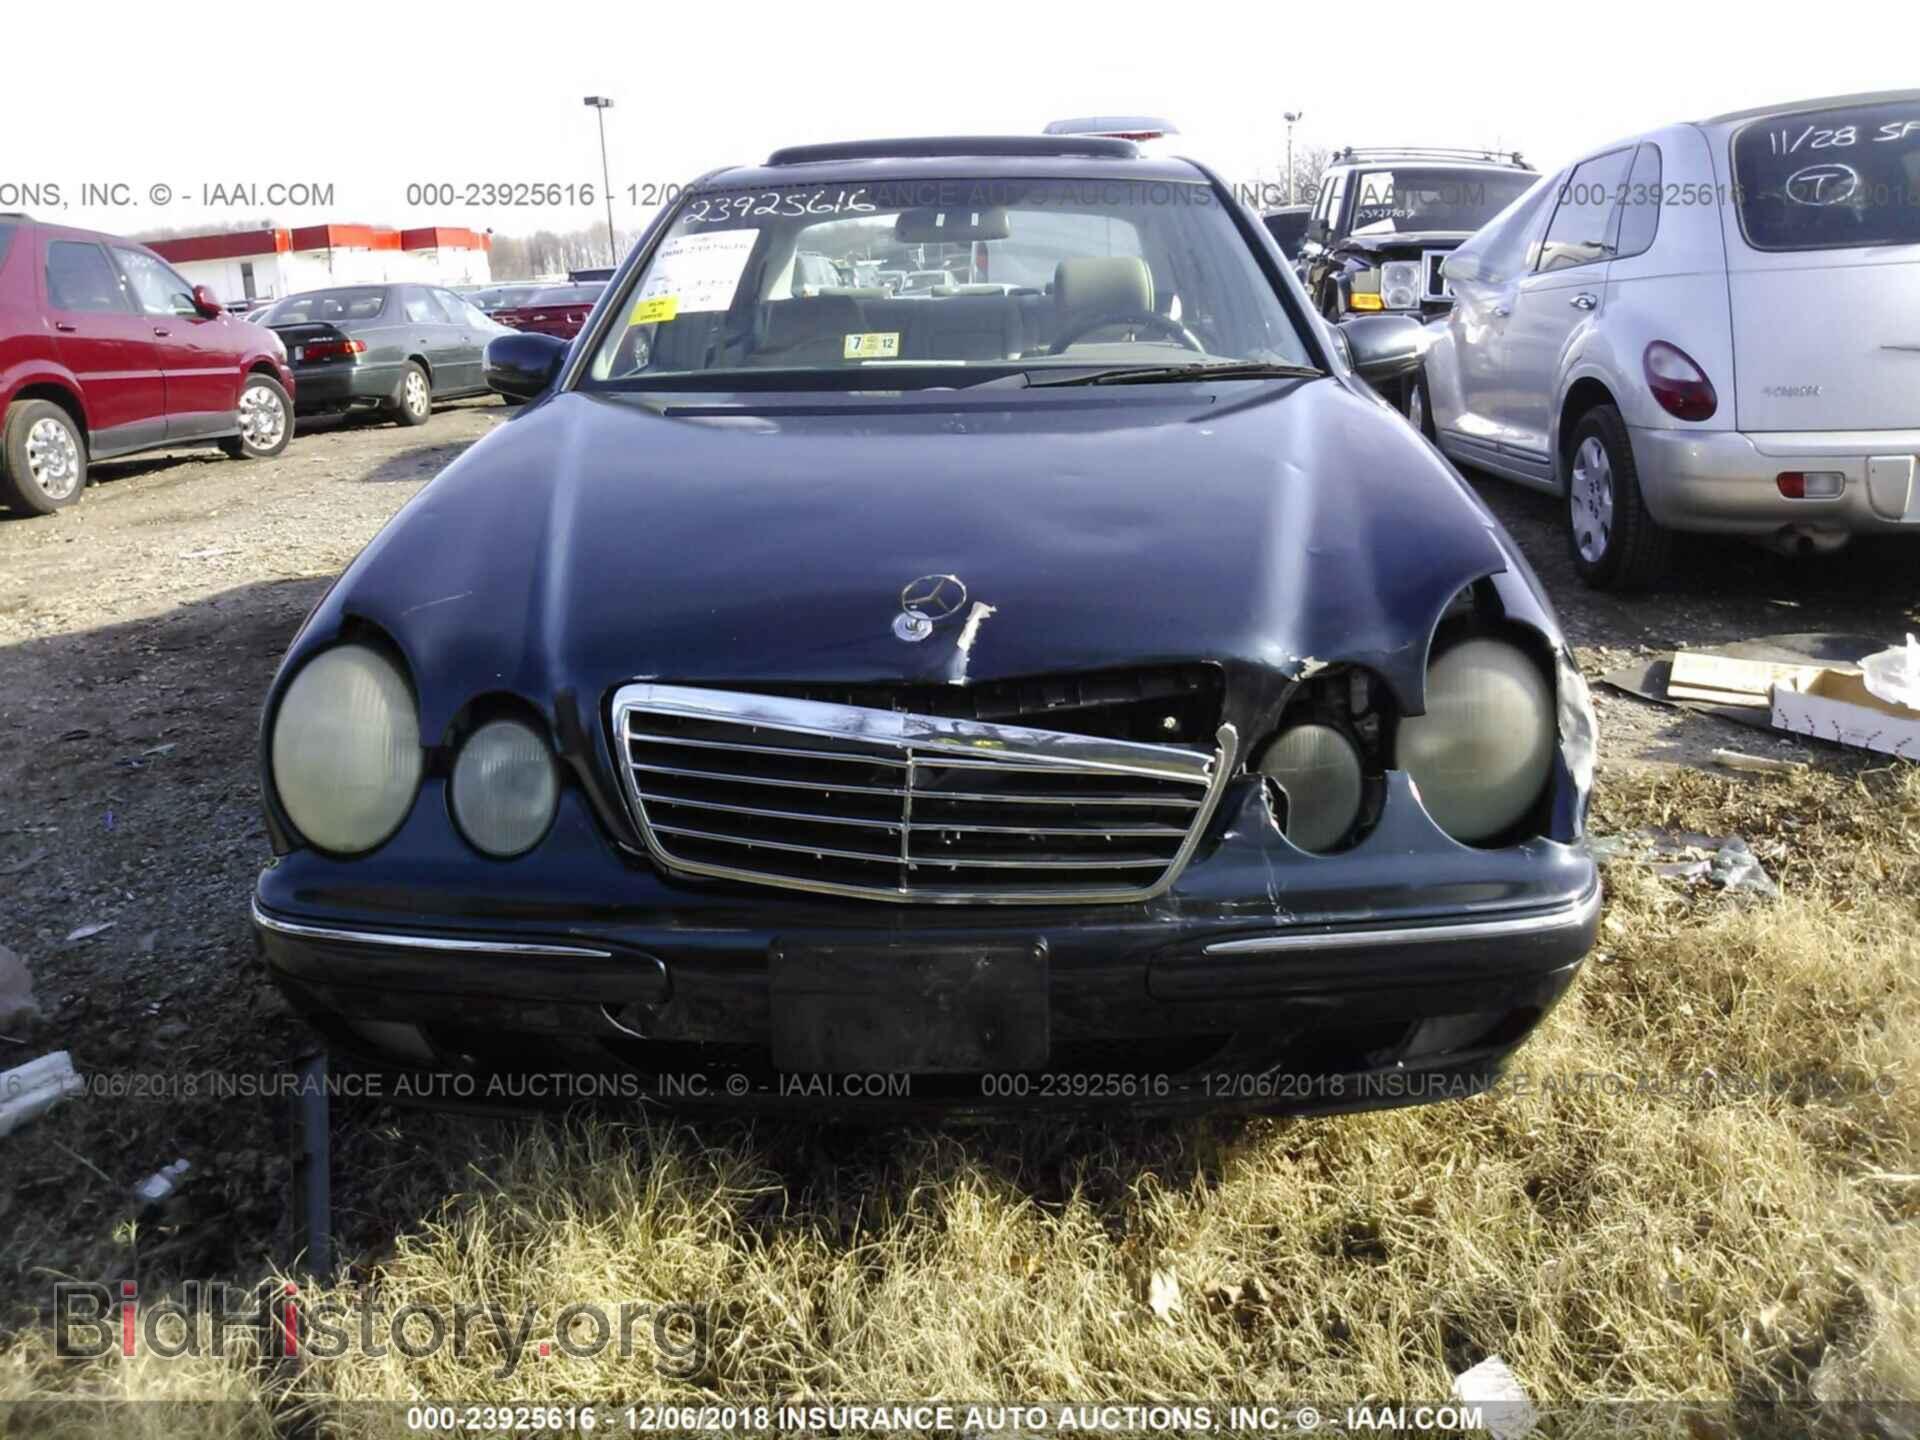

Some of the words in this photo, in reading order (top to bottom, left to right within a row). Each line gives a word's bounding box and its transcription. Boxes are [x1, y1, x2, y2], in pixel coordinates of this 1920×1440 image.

[1770, 125, 1857, 155] 11/28
[683, 189, 877, 224] 23925616
[853, 336, 862, 350] 7
[882, 338, 894, 349] 12
